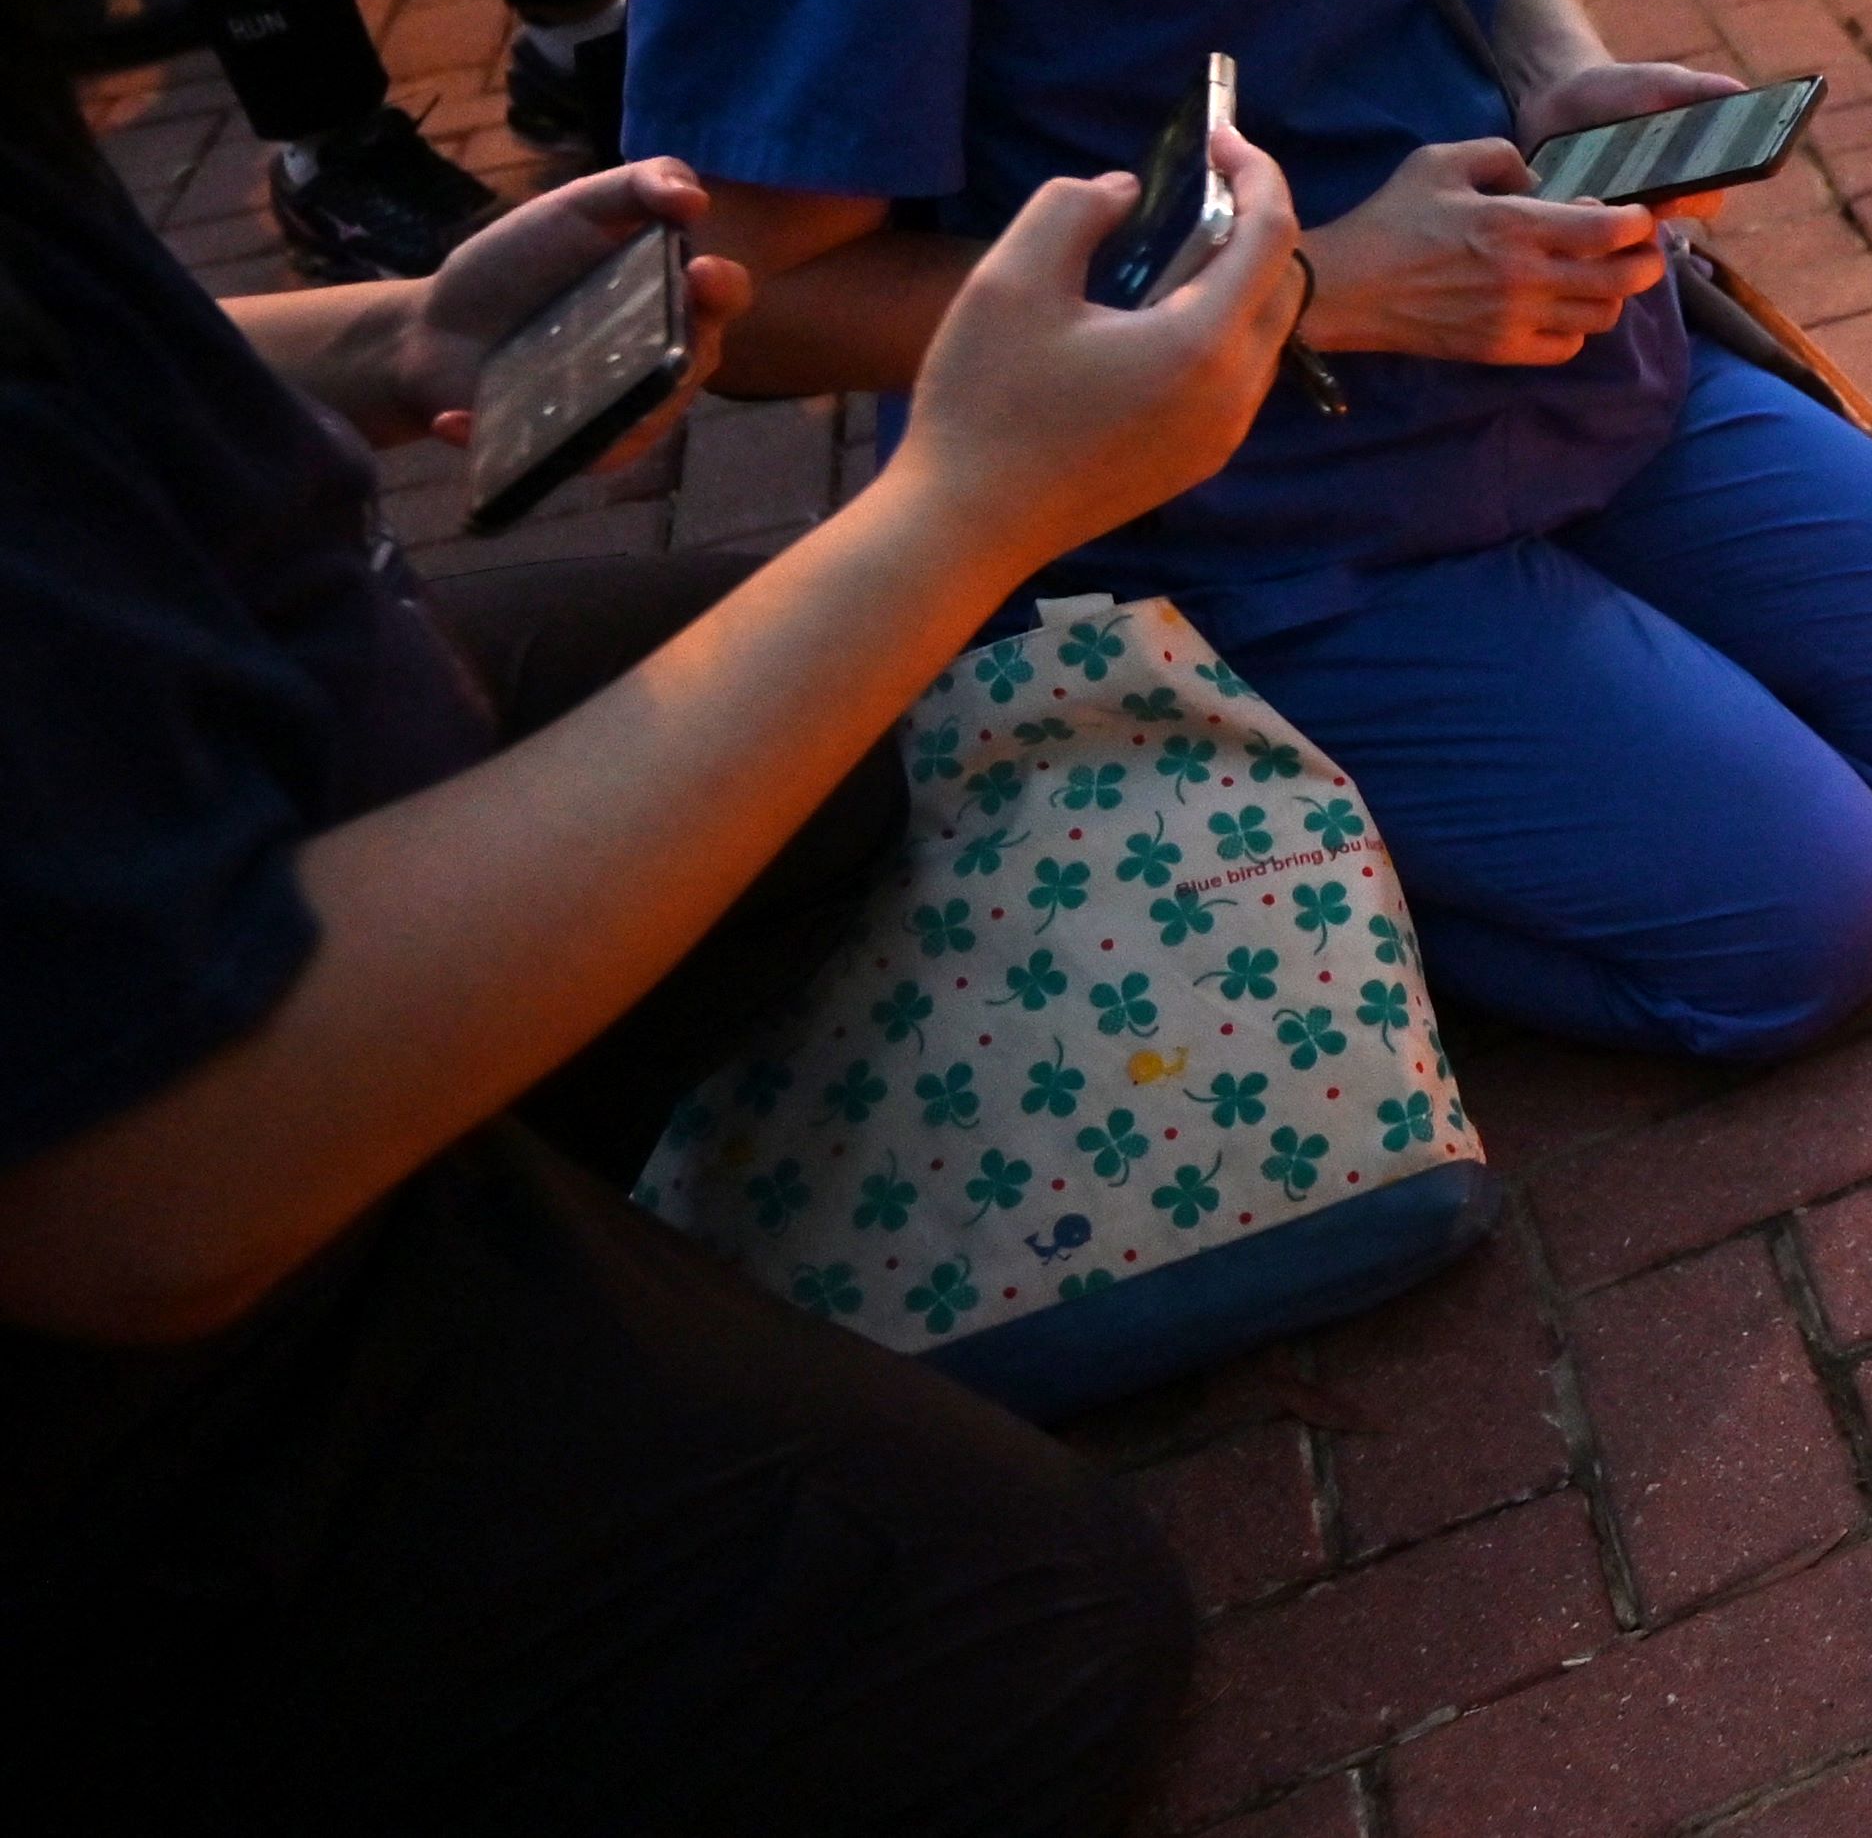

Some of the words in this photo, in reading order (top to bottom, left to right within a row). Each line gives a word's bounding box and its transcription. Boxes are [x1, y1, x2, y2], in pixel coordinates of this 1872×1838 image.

[1174, 875, 1222, 897] Blue
[1226, 860, 1267, 885] bird
[1270, 848, 1324, 873] bring
[1326, 841, 1361, 862] you
